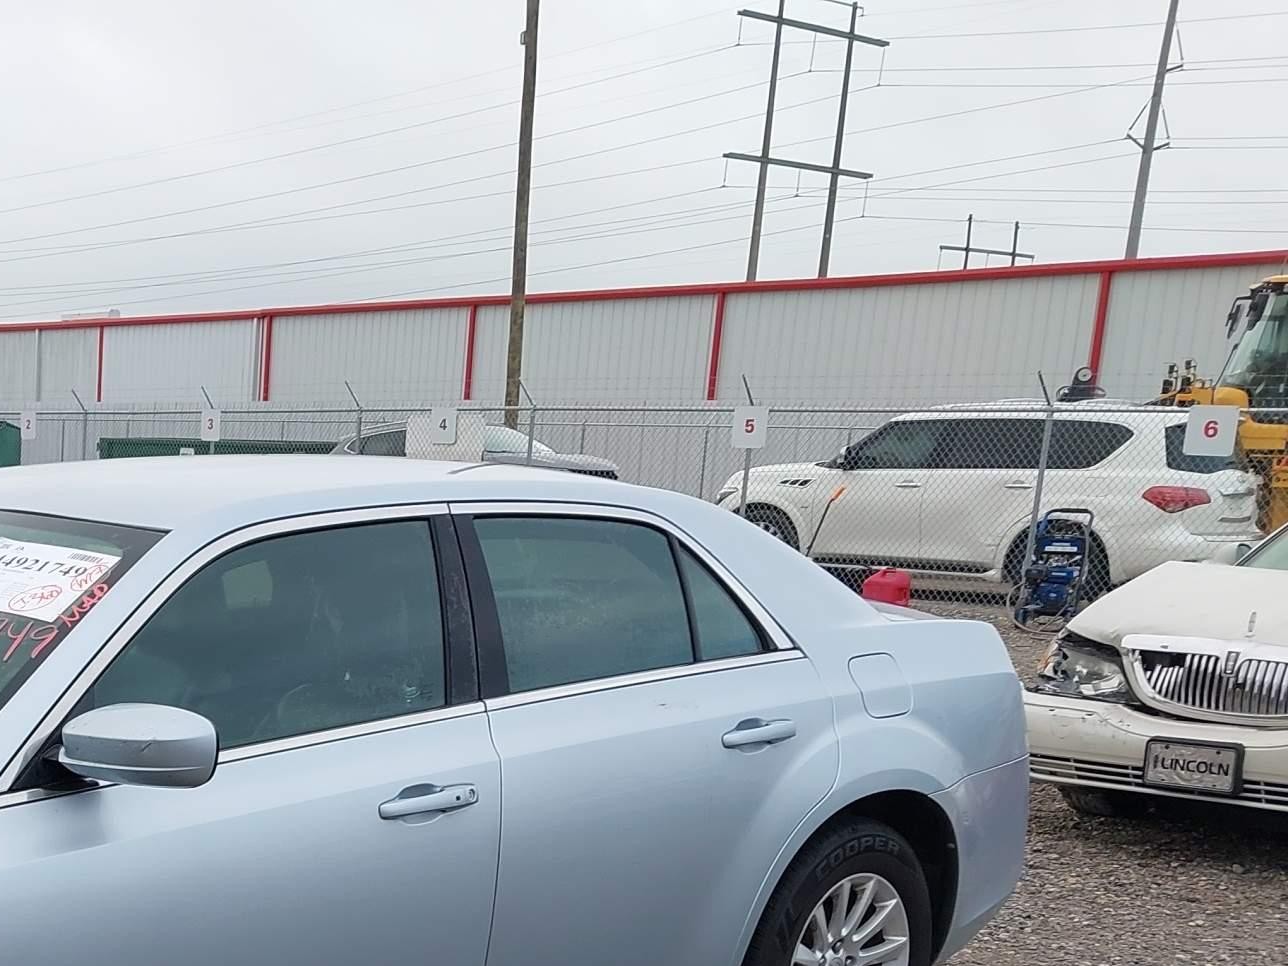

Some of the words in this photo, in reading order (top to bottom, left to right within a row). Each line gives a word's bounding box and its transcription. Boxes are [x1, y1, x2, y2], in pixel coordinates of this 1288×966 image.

[25, 419, 32, 430] 2
[207, 418, 214, 430] 3
[439, 418, 448, 431] 4
[745, 418, 755, 434] 5
[1203, 420, 1219, 438] 6
[1161, 757, 1230, 777] LINCOLN
